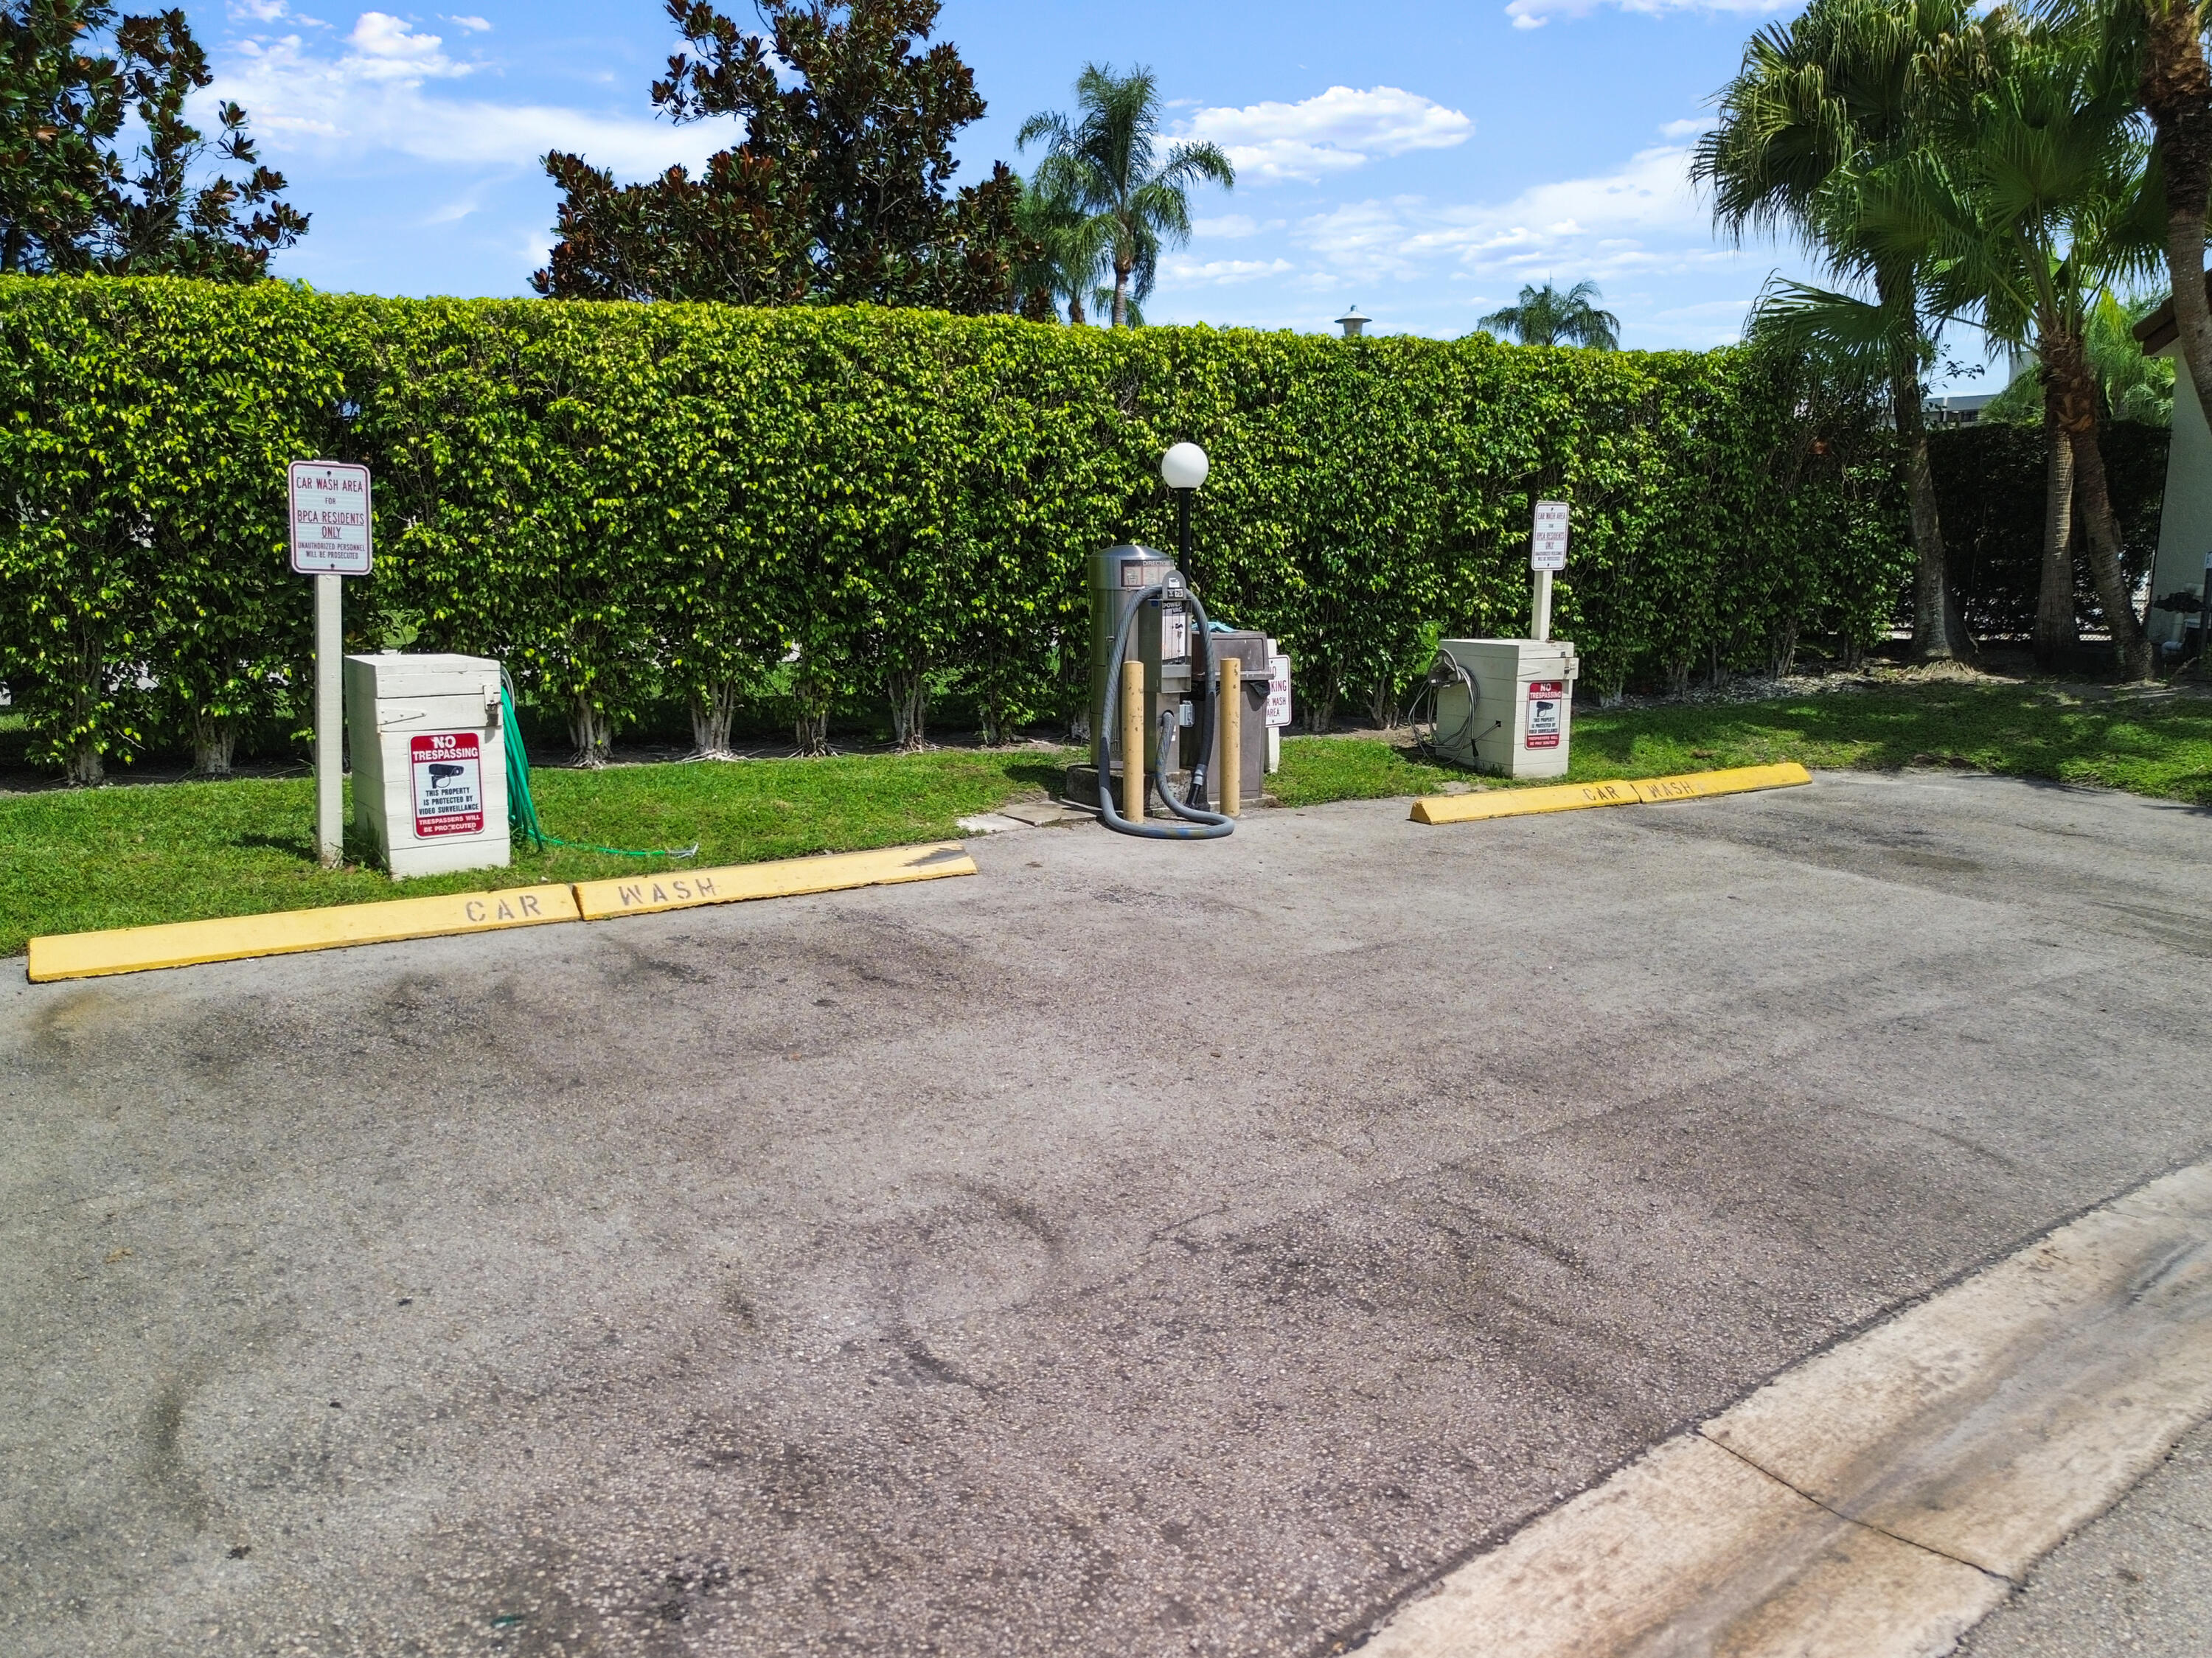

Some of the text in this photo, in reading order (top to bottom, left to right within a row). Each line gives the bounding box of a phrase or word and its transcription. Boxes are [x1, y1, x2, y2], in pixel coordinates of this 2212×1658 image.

[297, 477, 363, 492] CAR WASH AREA
[298, 510, 364, 524] BPCA RESIDENTS
[322, 526, 341, 538] ONLY
[338, 543, 365, 551] PERSONNEL
[1271, 680, 1287, 692] KING
[1272, 697, 1286, 706] WASH
[434, 736, 456, 748] NO
[413, 748, 478, 761] TRESPASSING
[442, 787, 470, 795] PROPERTY
[1583, 781, 1694, 801] CAR WASH
[432, 797, 463, 805] PROTECTED
[438, 804, 479, 812] SURVEILLANCE
[419, 816, 463, 825] TRESPASSERS
[465, 877, 717, 922] CAR WASH
